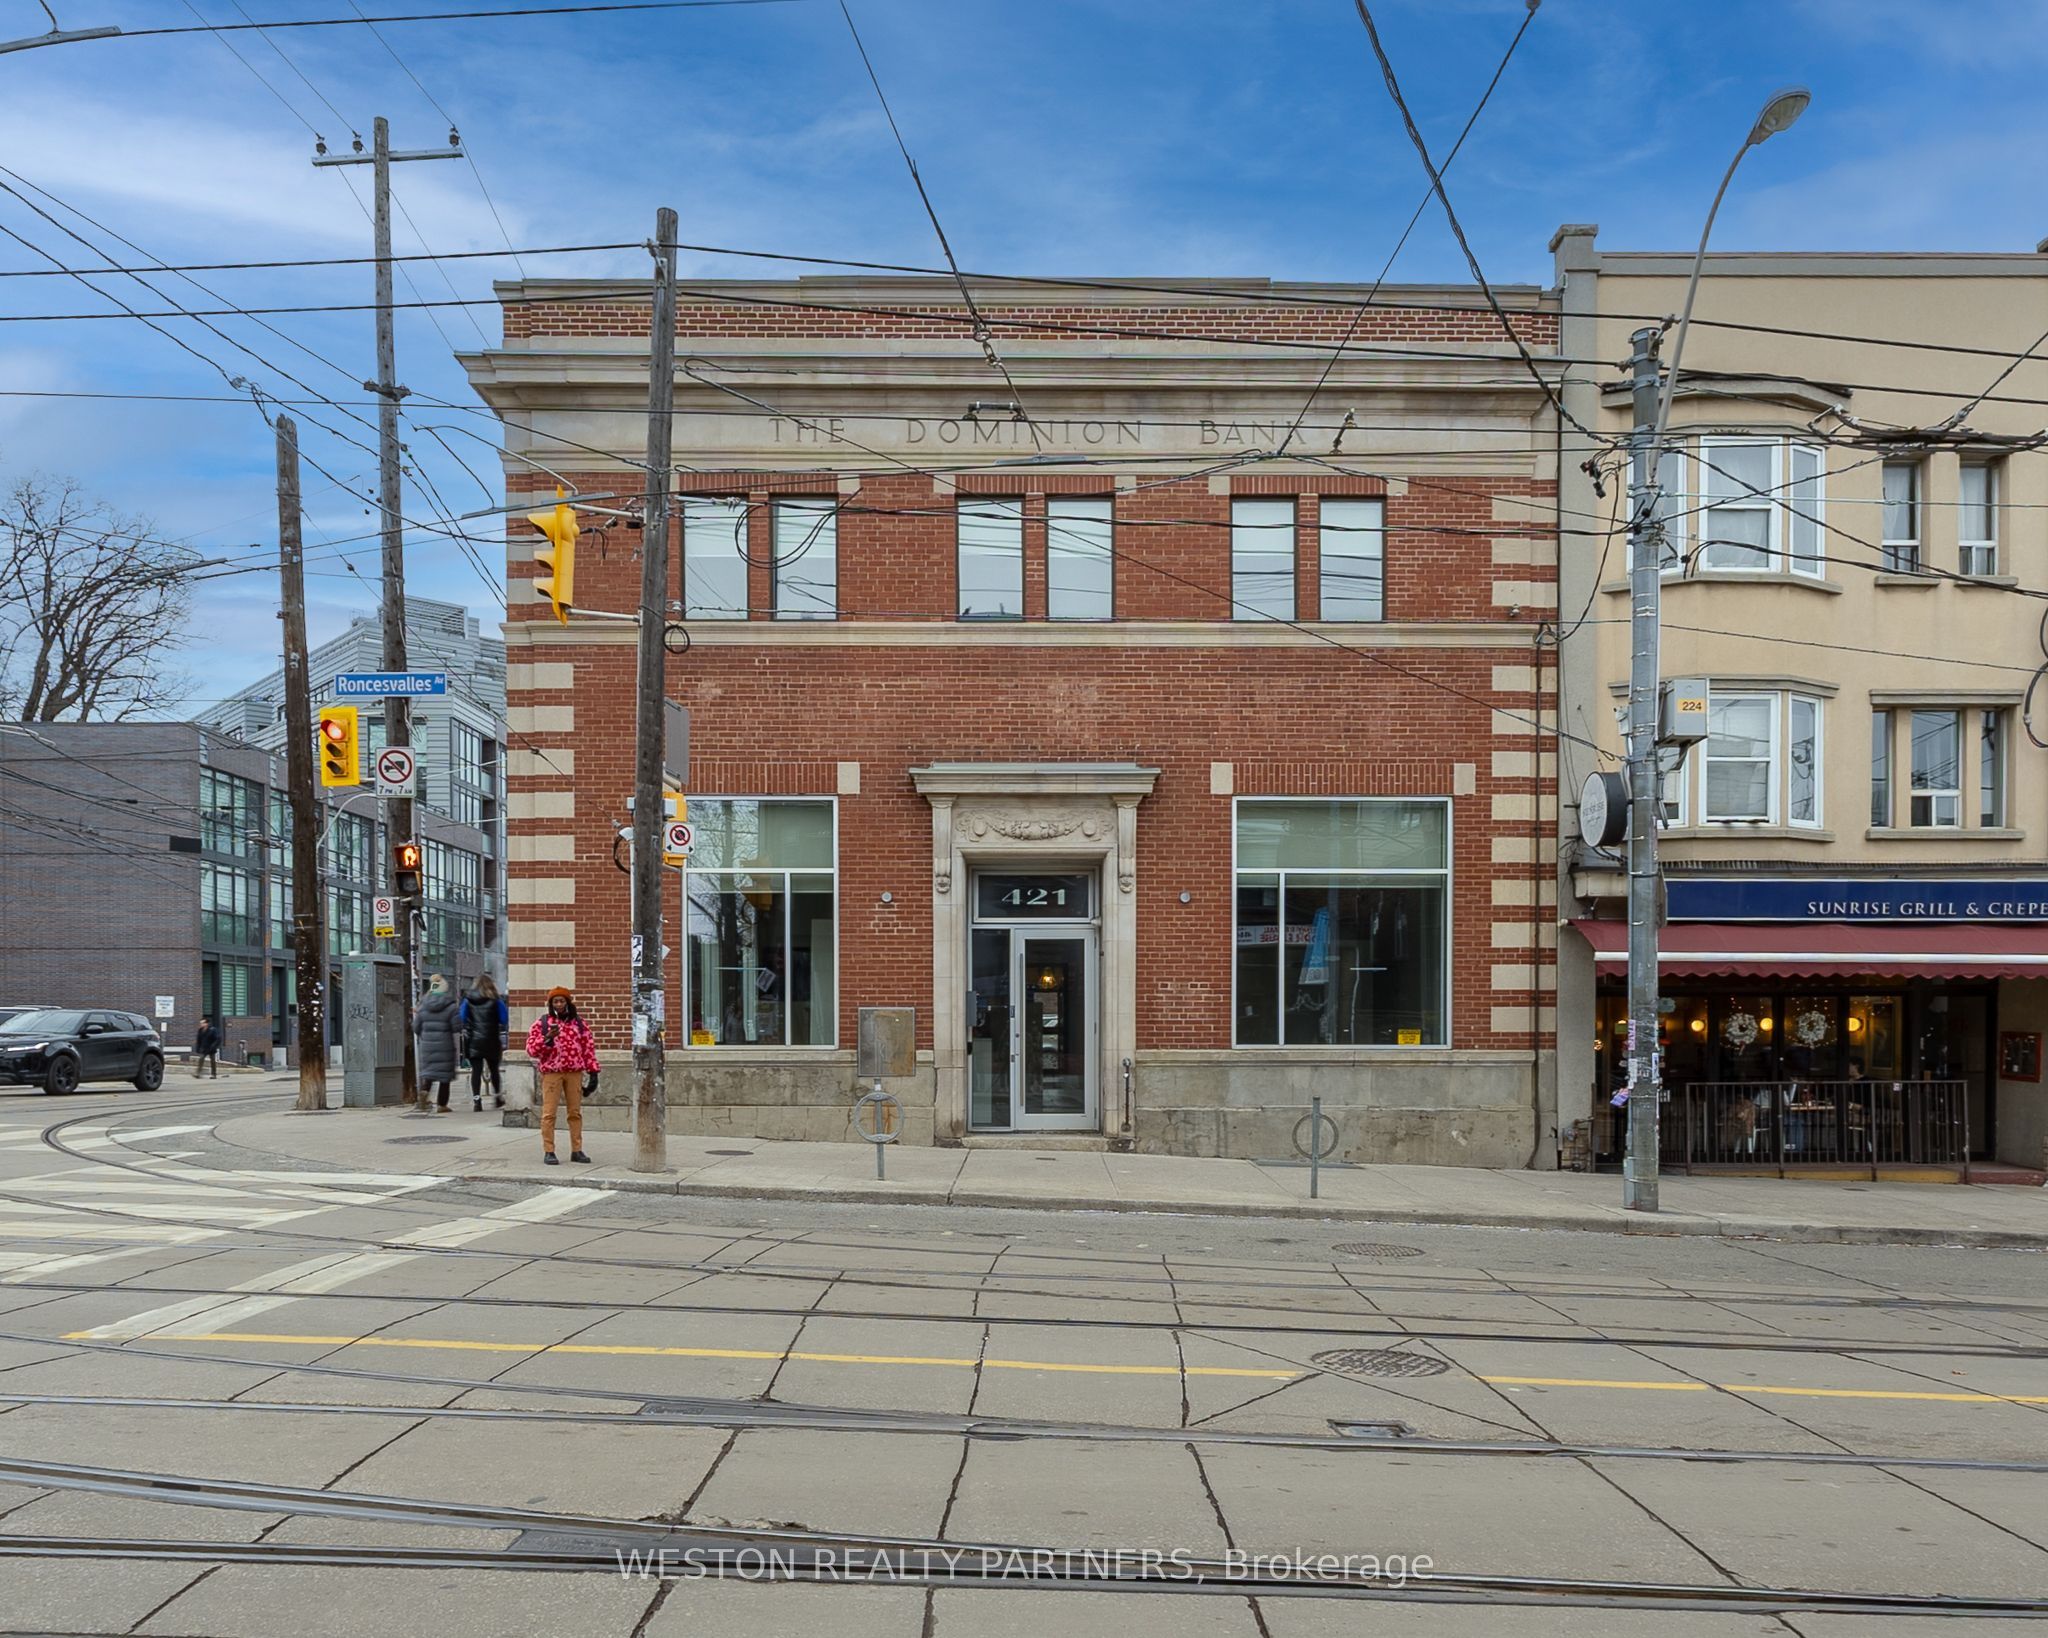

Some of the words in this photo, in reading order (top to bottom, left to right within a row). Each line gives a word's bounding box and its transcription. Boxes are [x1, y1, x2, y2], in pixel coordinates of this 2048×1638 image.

[769, 418, 845, 443] THE
[906, 419, 1142, 444] DOMINION
[1199, 420, 1306, 445] BANK
[338, 676, 432, 692] Roncesvalles
[1682, 702, 1702, 711] 224
[1001, 888, 1065, 905] 421
[1807, 901, 1890, 915] SUNRISE
[1900, 902, 1957, 915] GRILL
[1966, 902, 1979, 915] &
